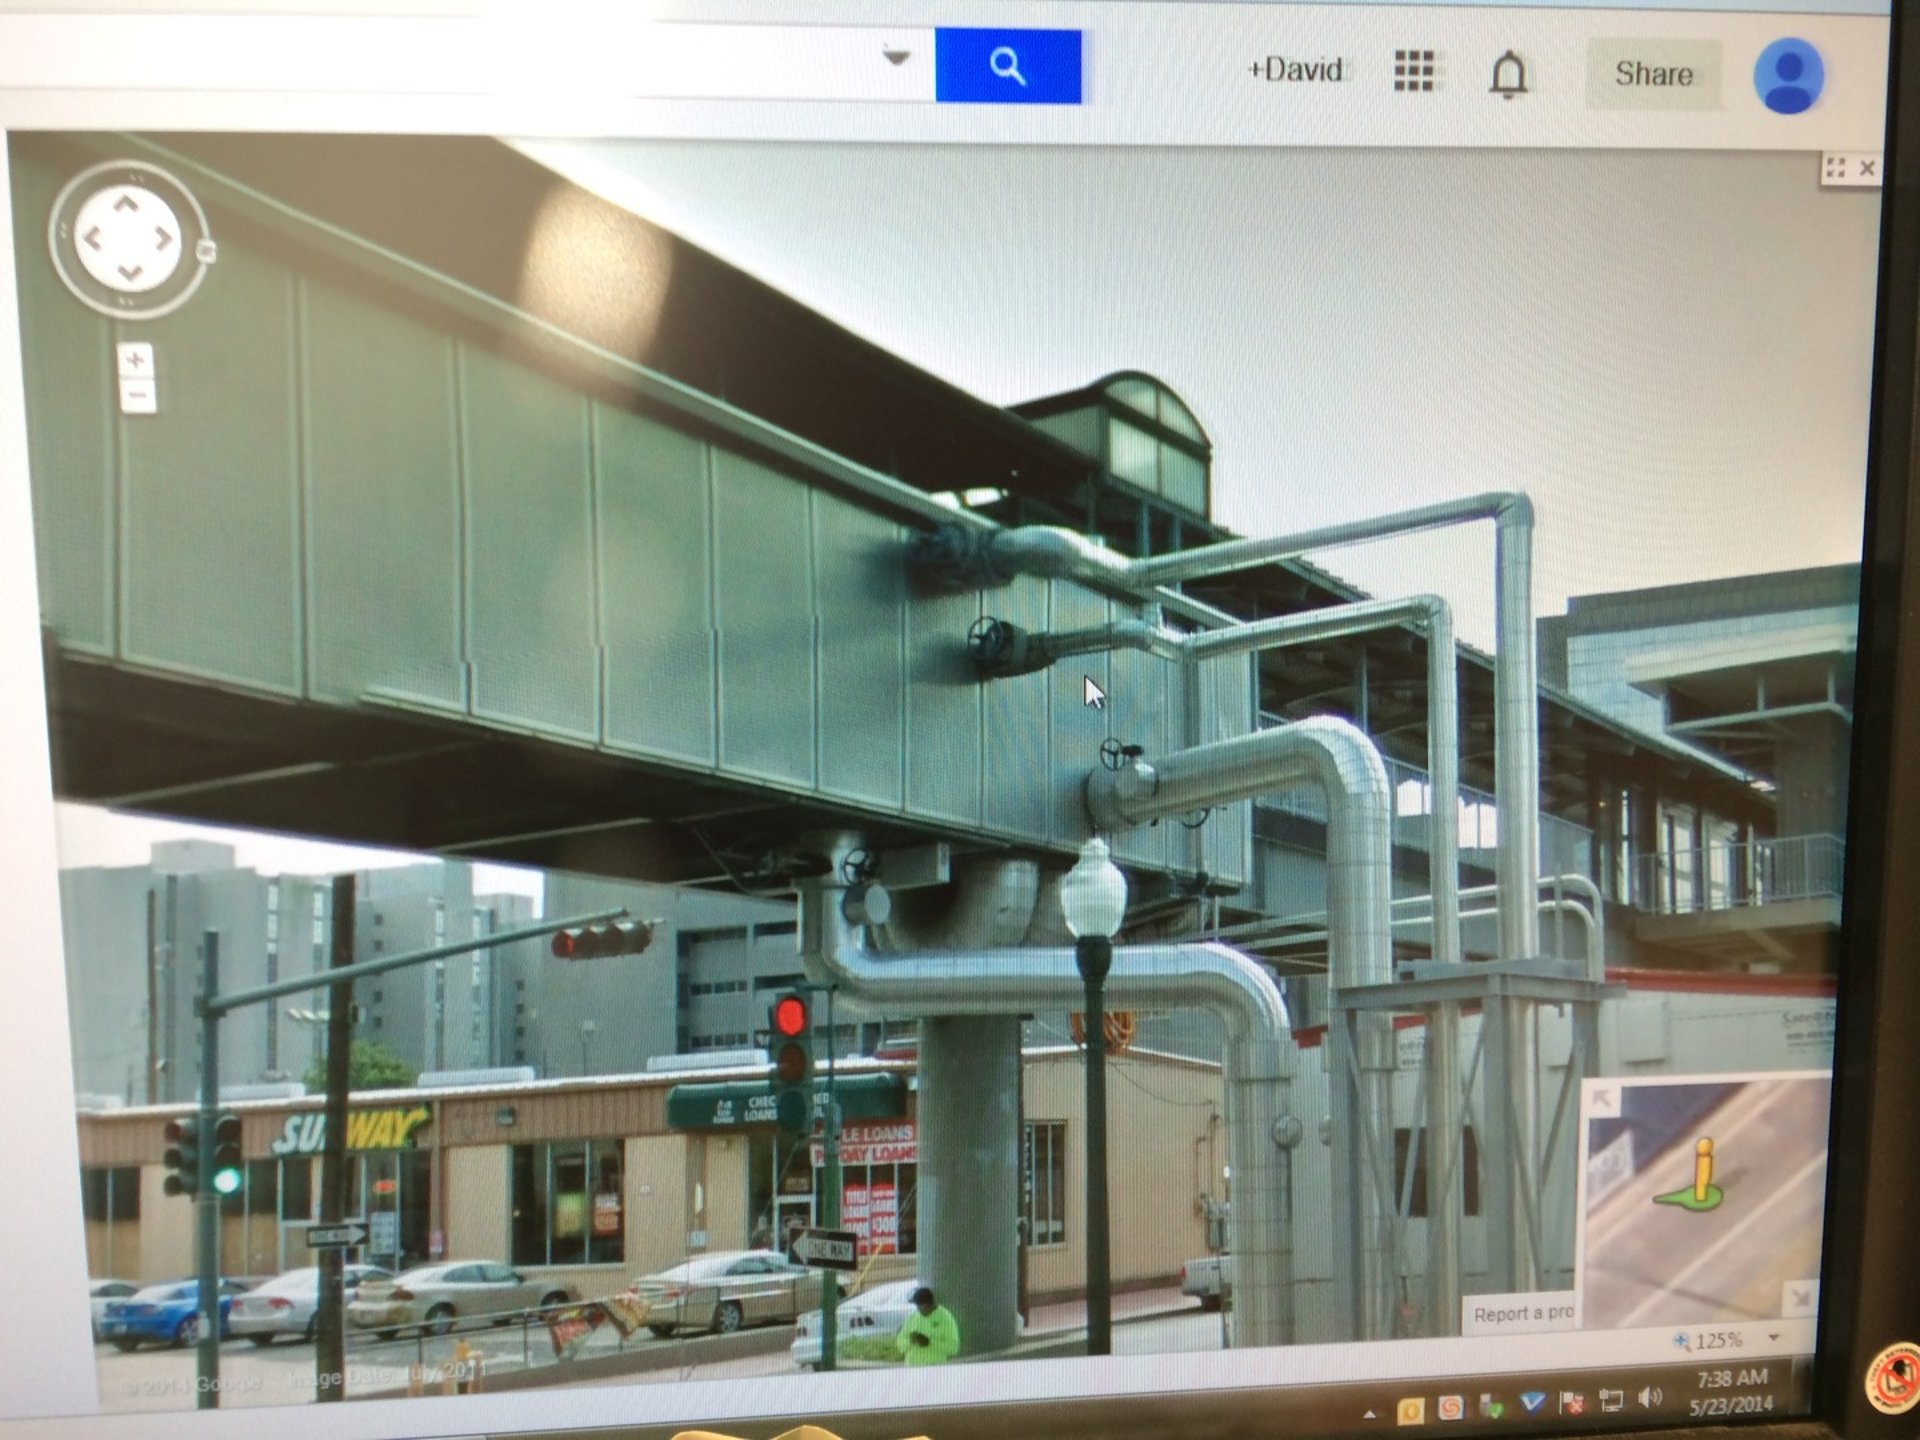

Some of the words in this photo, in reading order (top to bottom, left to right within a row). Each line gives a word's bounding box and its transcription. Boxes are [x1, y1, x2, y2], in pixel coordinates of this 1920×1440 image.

[1247, 55, 1342, 82] +David
[1616, 60, 1693, 86] Share
[272, 1108, 427, 1154] SUWAY
[863, 1125, 913, 1142] LOANS
[829, 1241, 852, 1260] WAY
[1475, 1307, 1528, 1324] Report
[1534, 1308, 1542, 1320] a
[1549, 1306, 1575, 1322] pro
[1697, 1332, 1743, 1350] 125%
[444, 1359, 489, 1382] 2011
[1698, 1370, 1732, 1389] 7:38
[1736, 1368, 1769, 1386] AM
[1689, 1395, 1773, 1417] 5/23/2014
